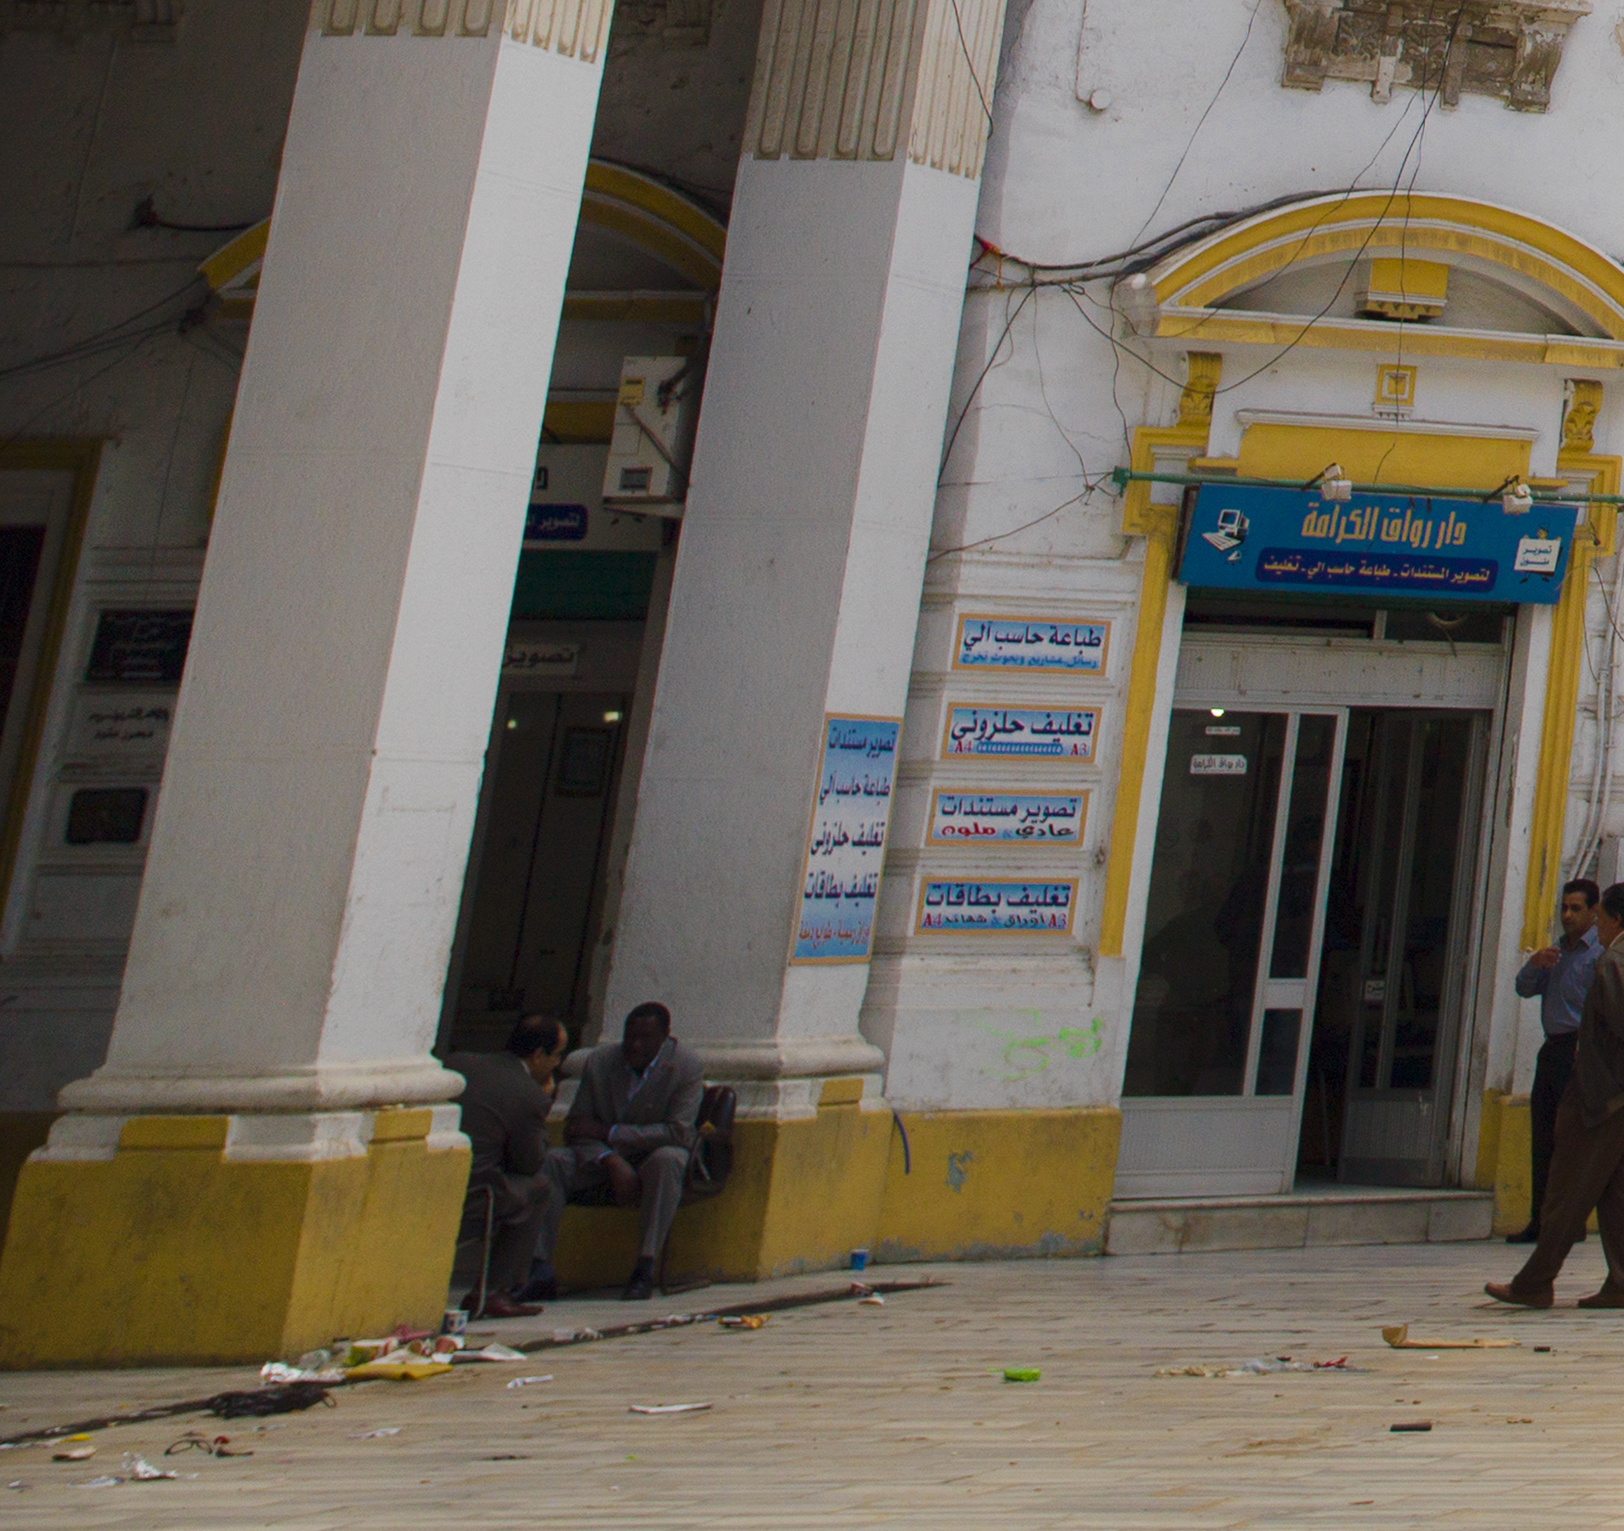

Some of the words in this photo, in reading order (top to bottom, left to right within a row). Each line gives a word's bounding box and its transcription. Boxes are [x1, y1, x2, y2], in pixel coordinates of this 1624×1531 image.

[1301, 501, 1380, 545] الكرامة
[1379, 507, 1433, 549] رواق
[1434, 510, 1468, 550] دار
[1263, 555, 1302, 575] تغليف
[1327, 562, 1356, 579] حاسب
[1359, 559, 1391, 581] طباعة
[1400, 564, 1450, 579] المستندات
[1449, 568, 1490, 584] لتصوير
[993, 625, 1045, 650] حاسب
[1048, 625, 1102, 655] طباعة
[829, 727, 867, 749] مستندات
[1030, 710, 1095, 743] تغليف
[866, 730, 896, 758] تصوير
[954, 740, 973, 753] A4
[1069, 742, 1088, 756] A3
[835, 775, 862, 804] حاسب
[863, 773, 891, 805] طباعة
[941, 796, 1018, 817] مستندات
[1018, 798, 1078, 824] تصوير
[852, 822, 887, 856] تغليف
[941, 821, 997, 837] ملون
[1015, 823, 1075, 838] عادي
[804, 871, 843, 908] بطاقات
[844, 872, 880, 908] تغليف
[925, 883, 1002, 914] بطاقات
[1006, 886, 1072, 915] تغليف
[923, 913, 943, 927] A4
[1048, 913, 1068, 927] A3
